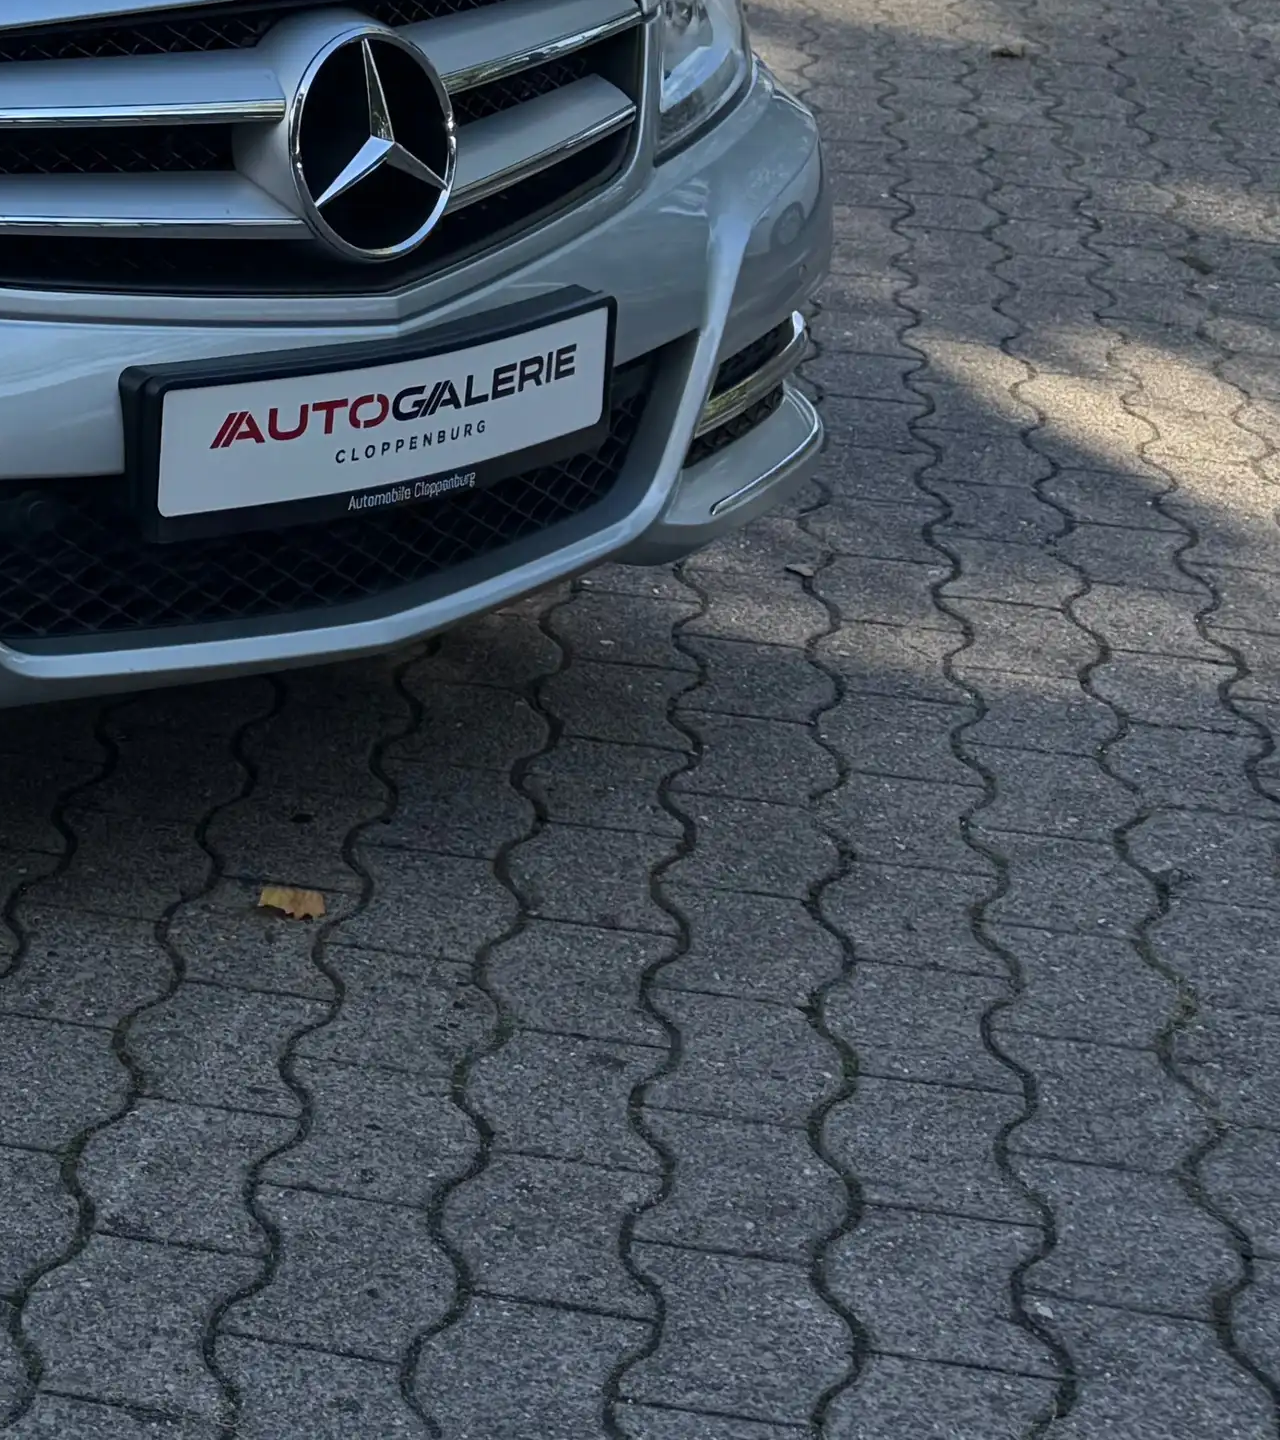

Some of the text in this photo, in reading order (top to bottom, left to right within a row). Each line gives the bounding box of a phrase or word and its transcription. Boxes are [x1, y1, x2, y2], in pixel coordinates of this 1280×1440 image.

[209, 343, 578, 450] AUTOGALERIE
[334, 419, 488, 464] CLOPPENBURG
[347, 471, 477, 511] Automobile Cloppenburg
